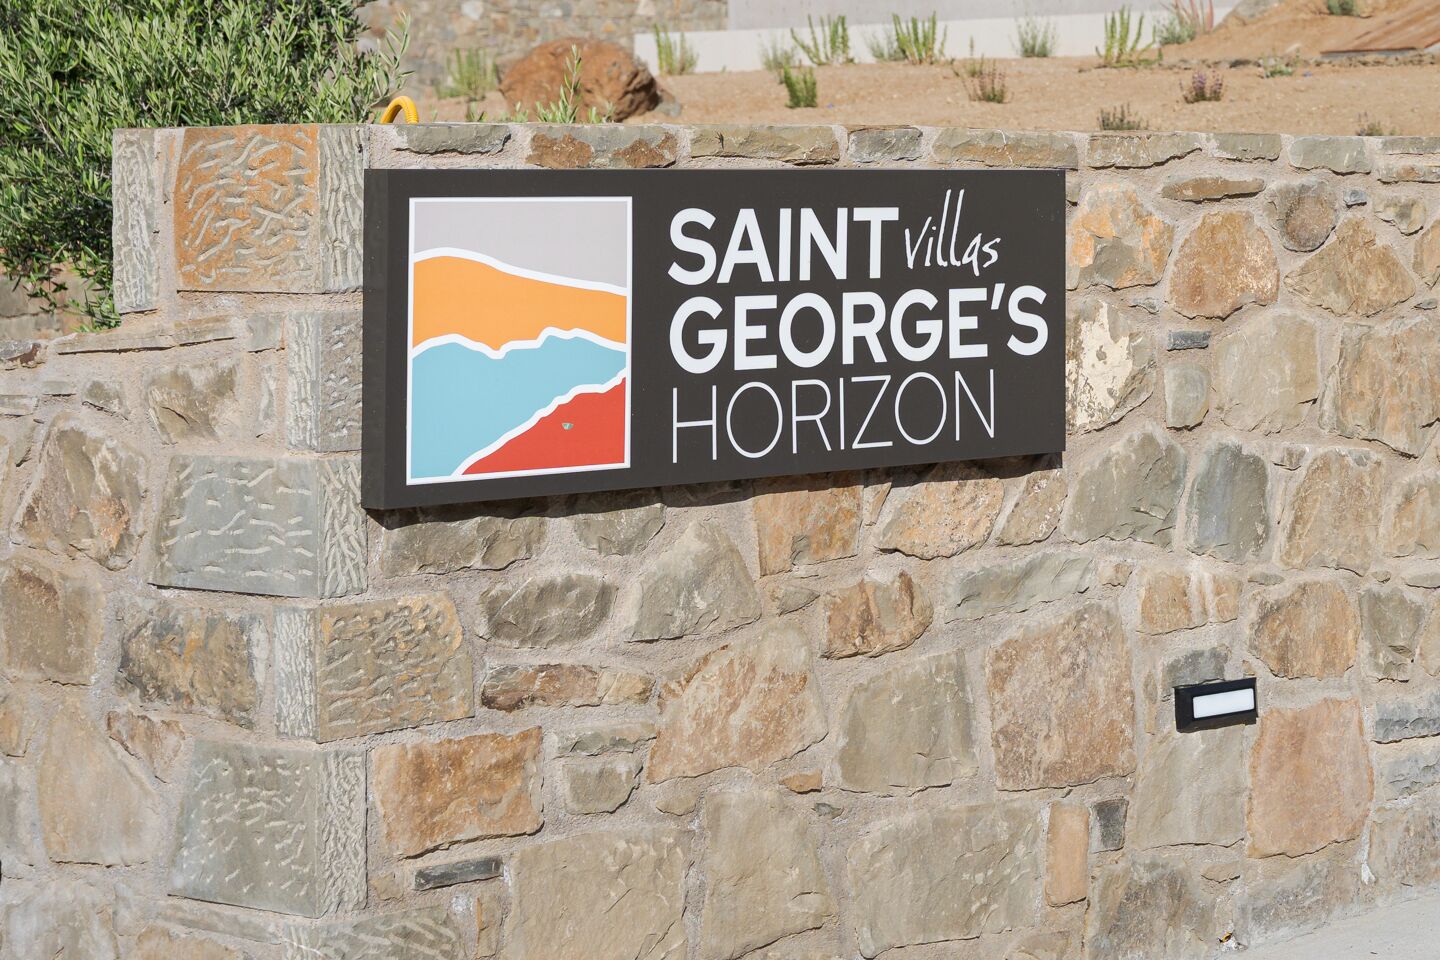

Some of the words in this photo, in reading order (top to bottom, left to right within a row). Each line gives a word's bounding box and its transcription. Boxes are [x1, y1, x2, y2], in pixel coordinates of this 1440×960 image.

[667, 206, 900, 286] SAINT
[669, 282, 1050, 375] GEORGE'S
[672, 368, 996, 464] HORIZON
